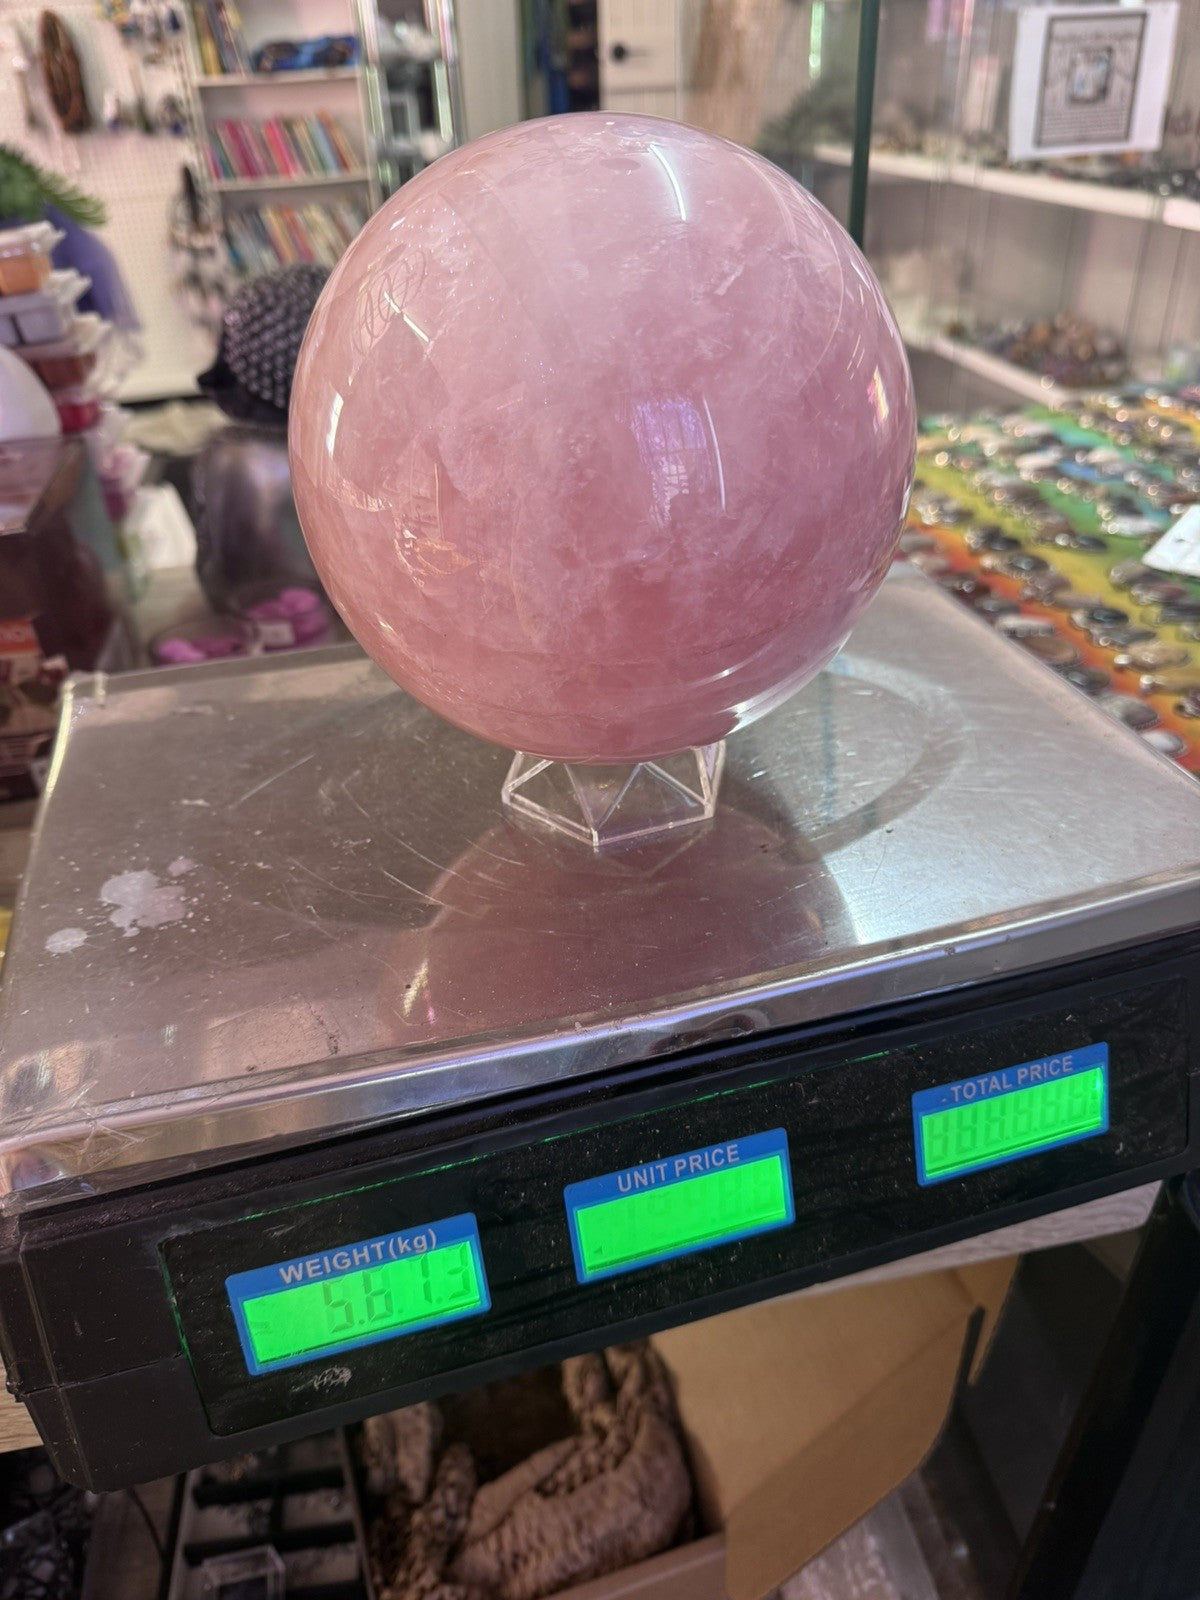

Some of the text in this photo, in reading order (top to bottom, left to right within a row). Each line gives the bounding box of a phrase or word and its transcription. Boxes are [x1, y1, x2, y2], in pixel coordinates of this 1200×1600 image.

[951, 1055, 1073, 1103] TOTAL PRICE
[617, 1144, 740, 1192] UNIT PRICE
[279, 1228, 437, 1285] WEIGHT(kg)
